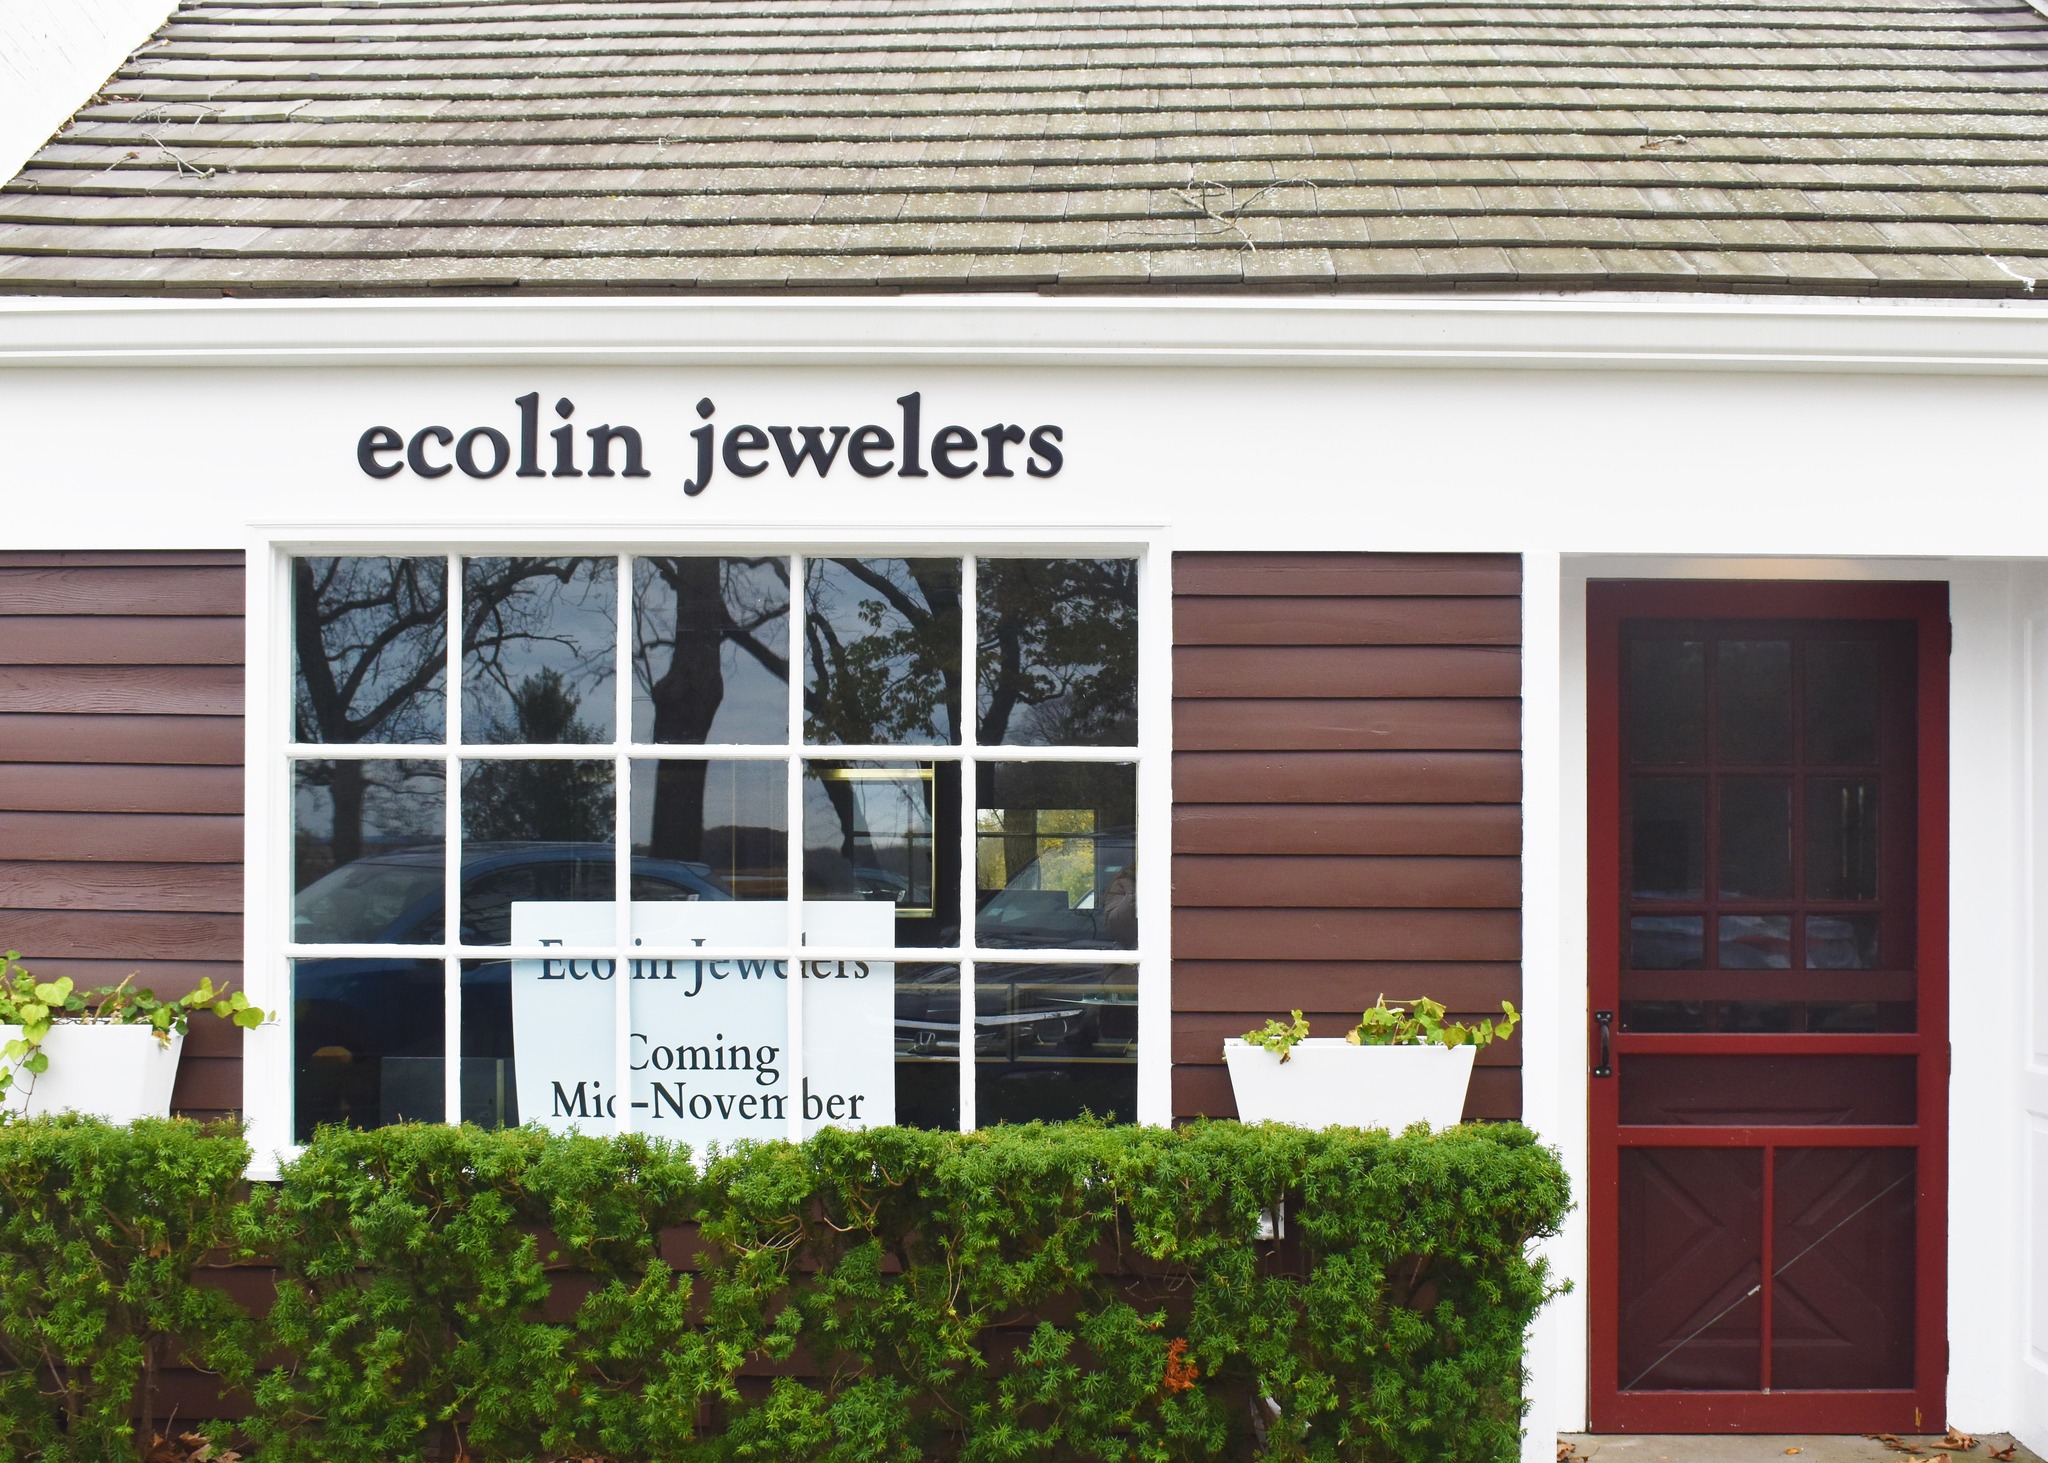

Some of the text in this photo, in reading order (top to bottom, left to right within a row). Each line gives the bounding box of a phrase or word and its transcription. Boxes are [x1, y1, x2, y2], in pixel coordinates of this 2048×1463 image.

[357, 391, 1064, 497] ecolin jewelers
[537, 938, 678, 981] Ecoin
